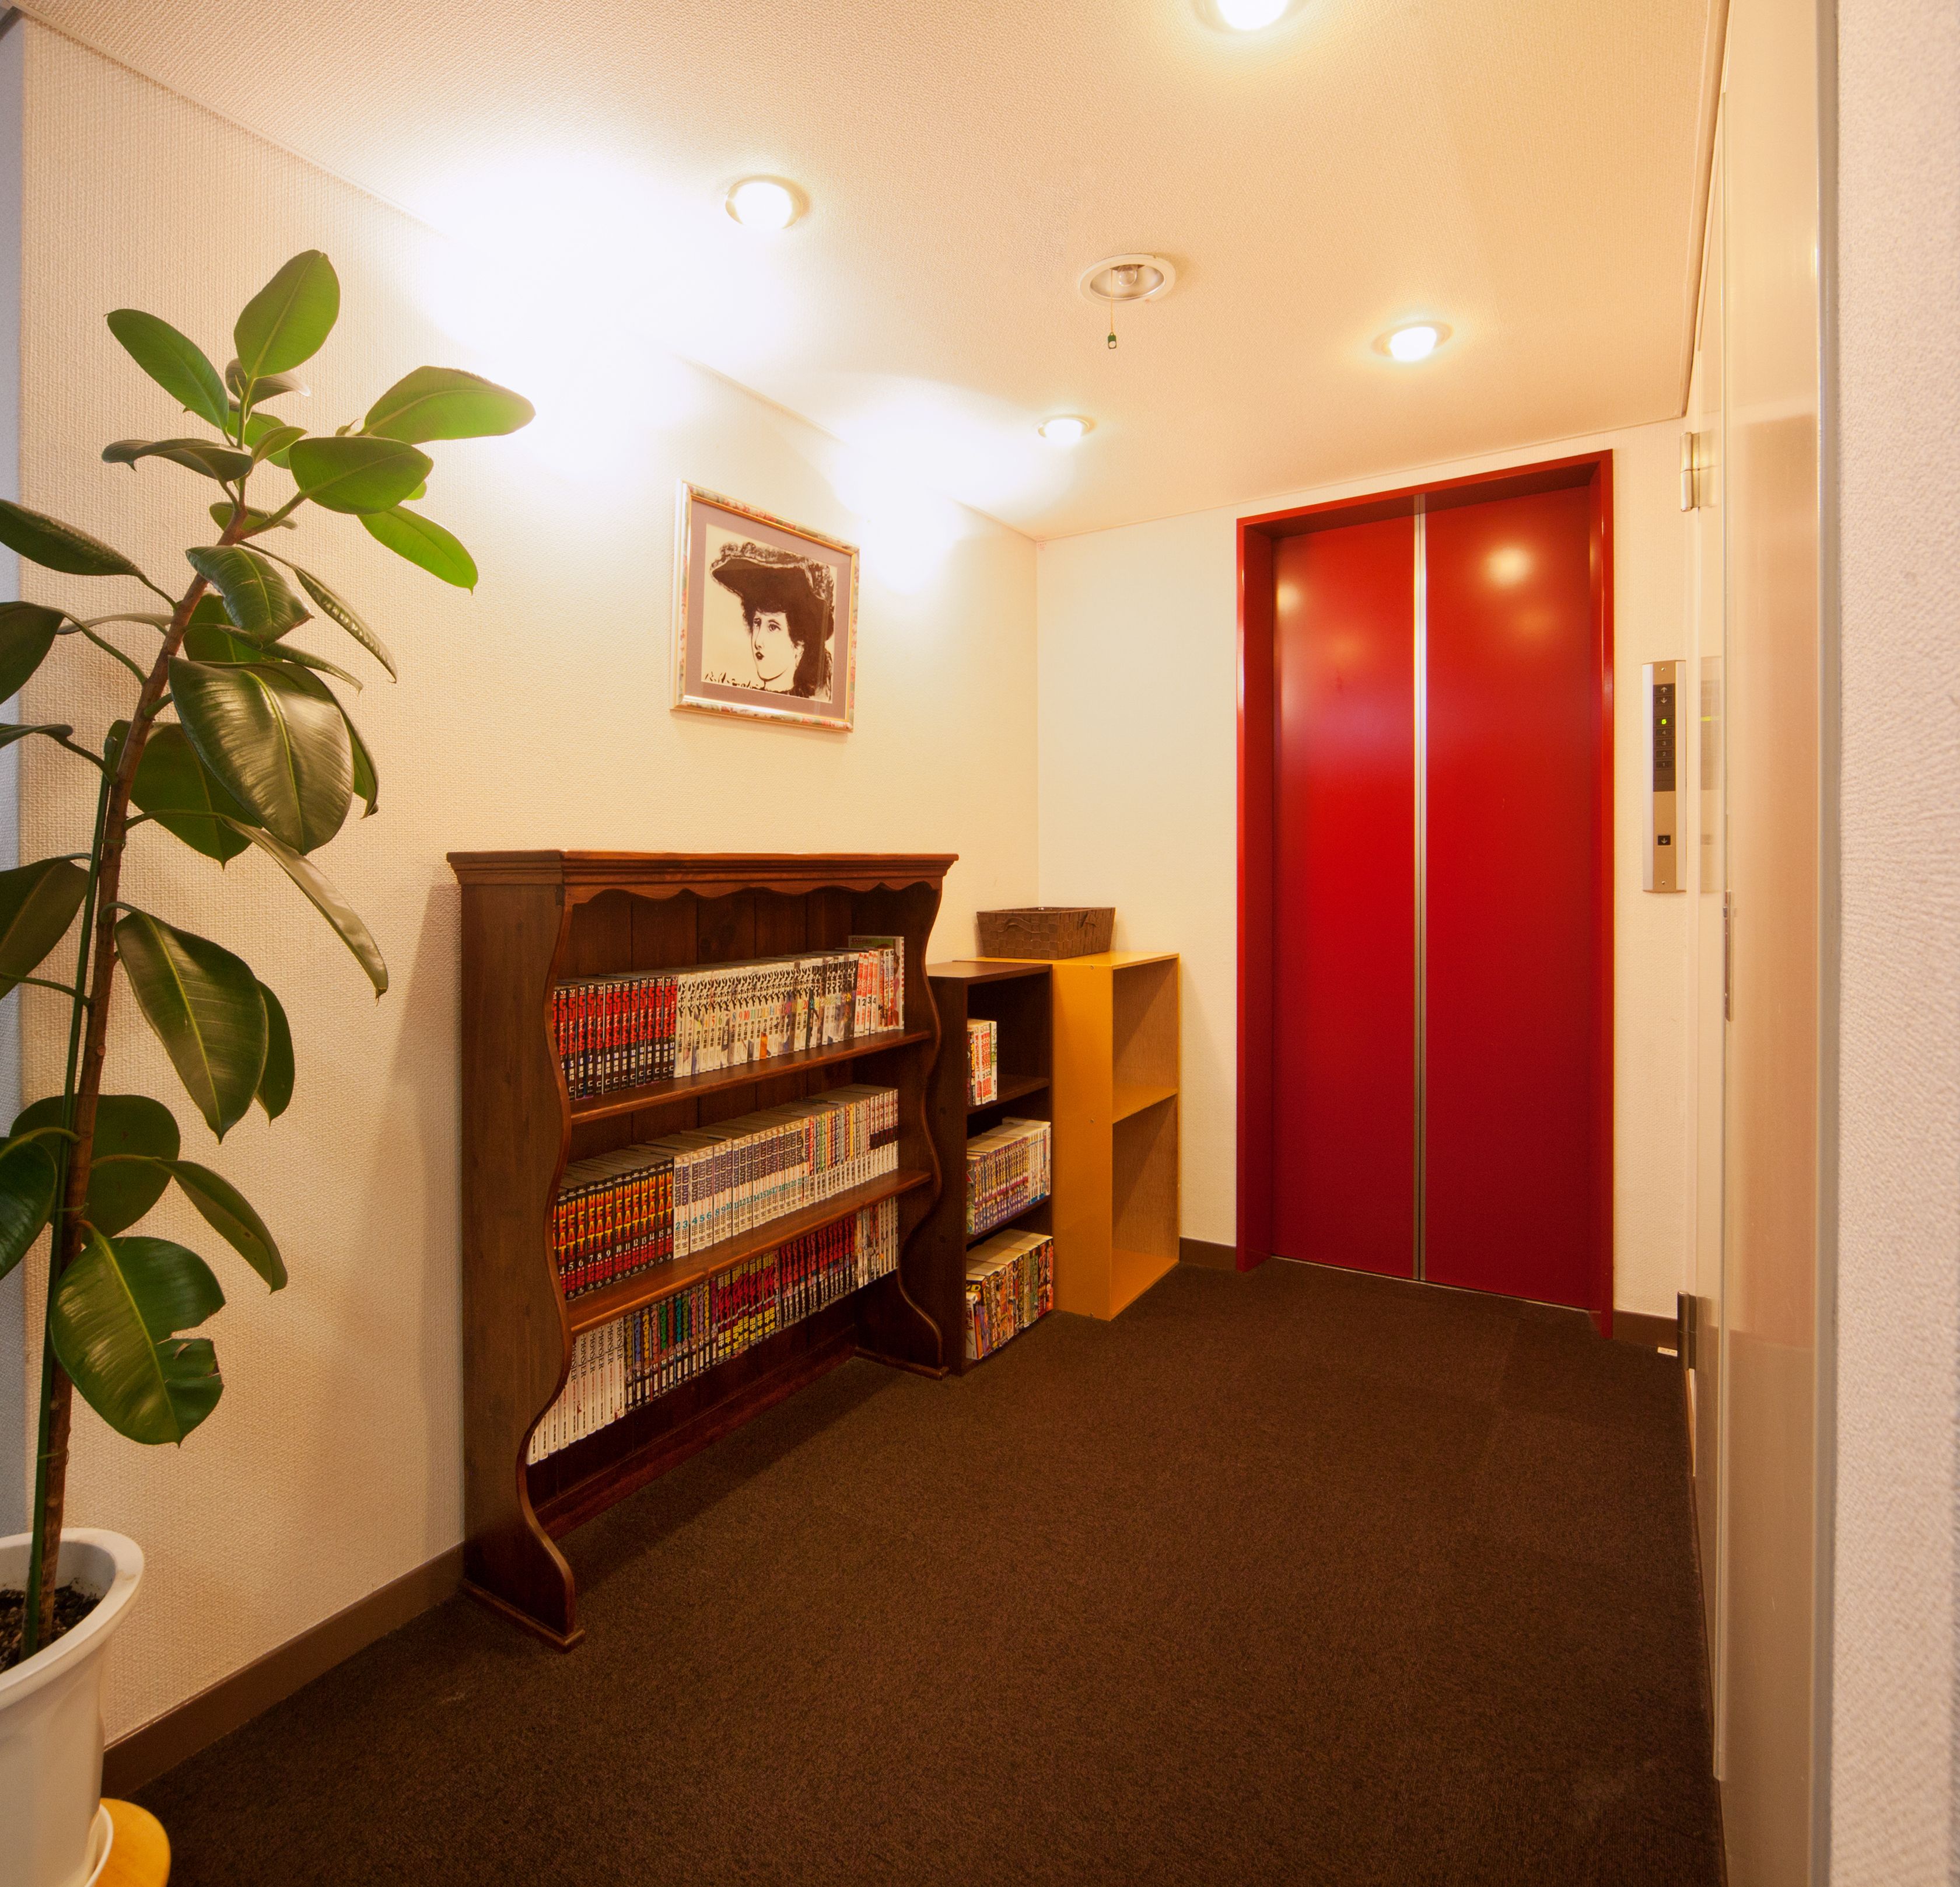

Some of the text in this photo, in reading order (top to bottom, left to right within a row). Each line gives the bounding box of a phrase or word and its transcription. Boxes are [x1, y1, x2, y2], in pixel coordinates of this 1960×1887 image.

[744, 1011, 750, 1021] 10
[558, 1205, 566, 1260] HEAT
[567, 1201, 575, 1256] HEAT
